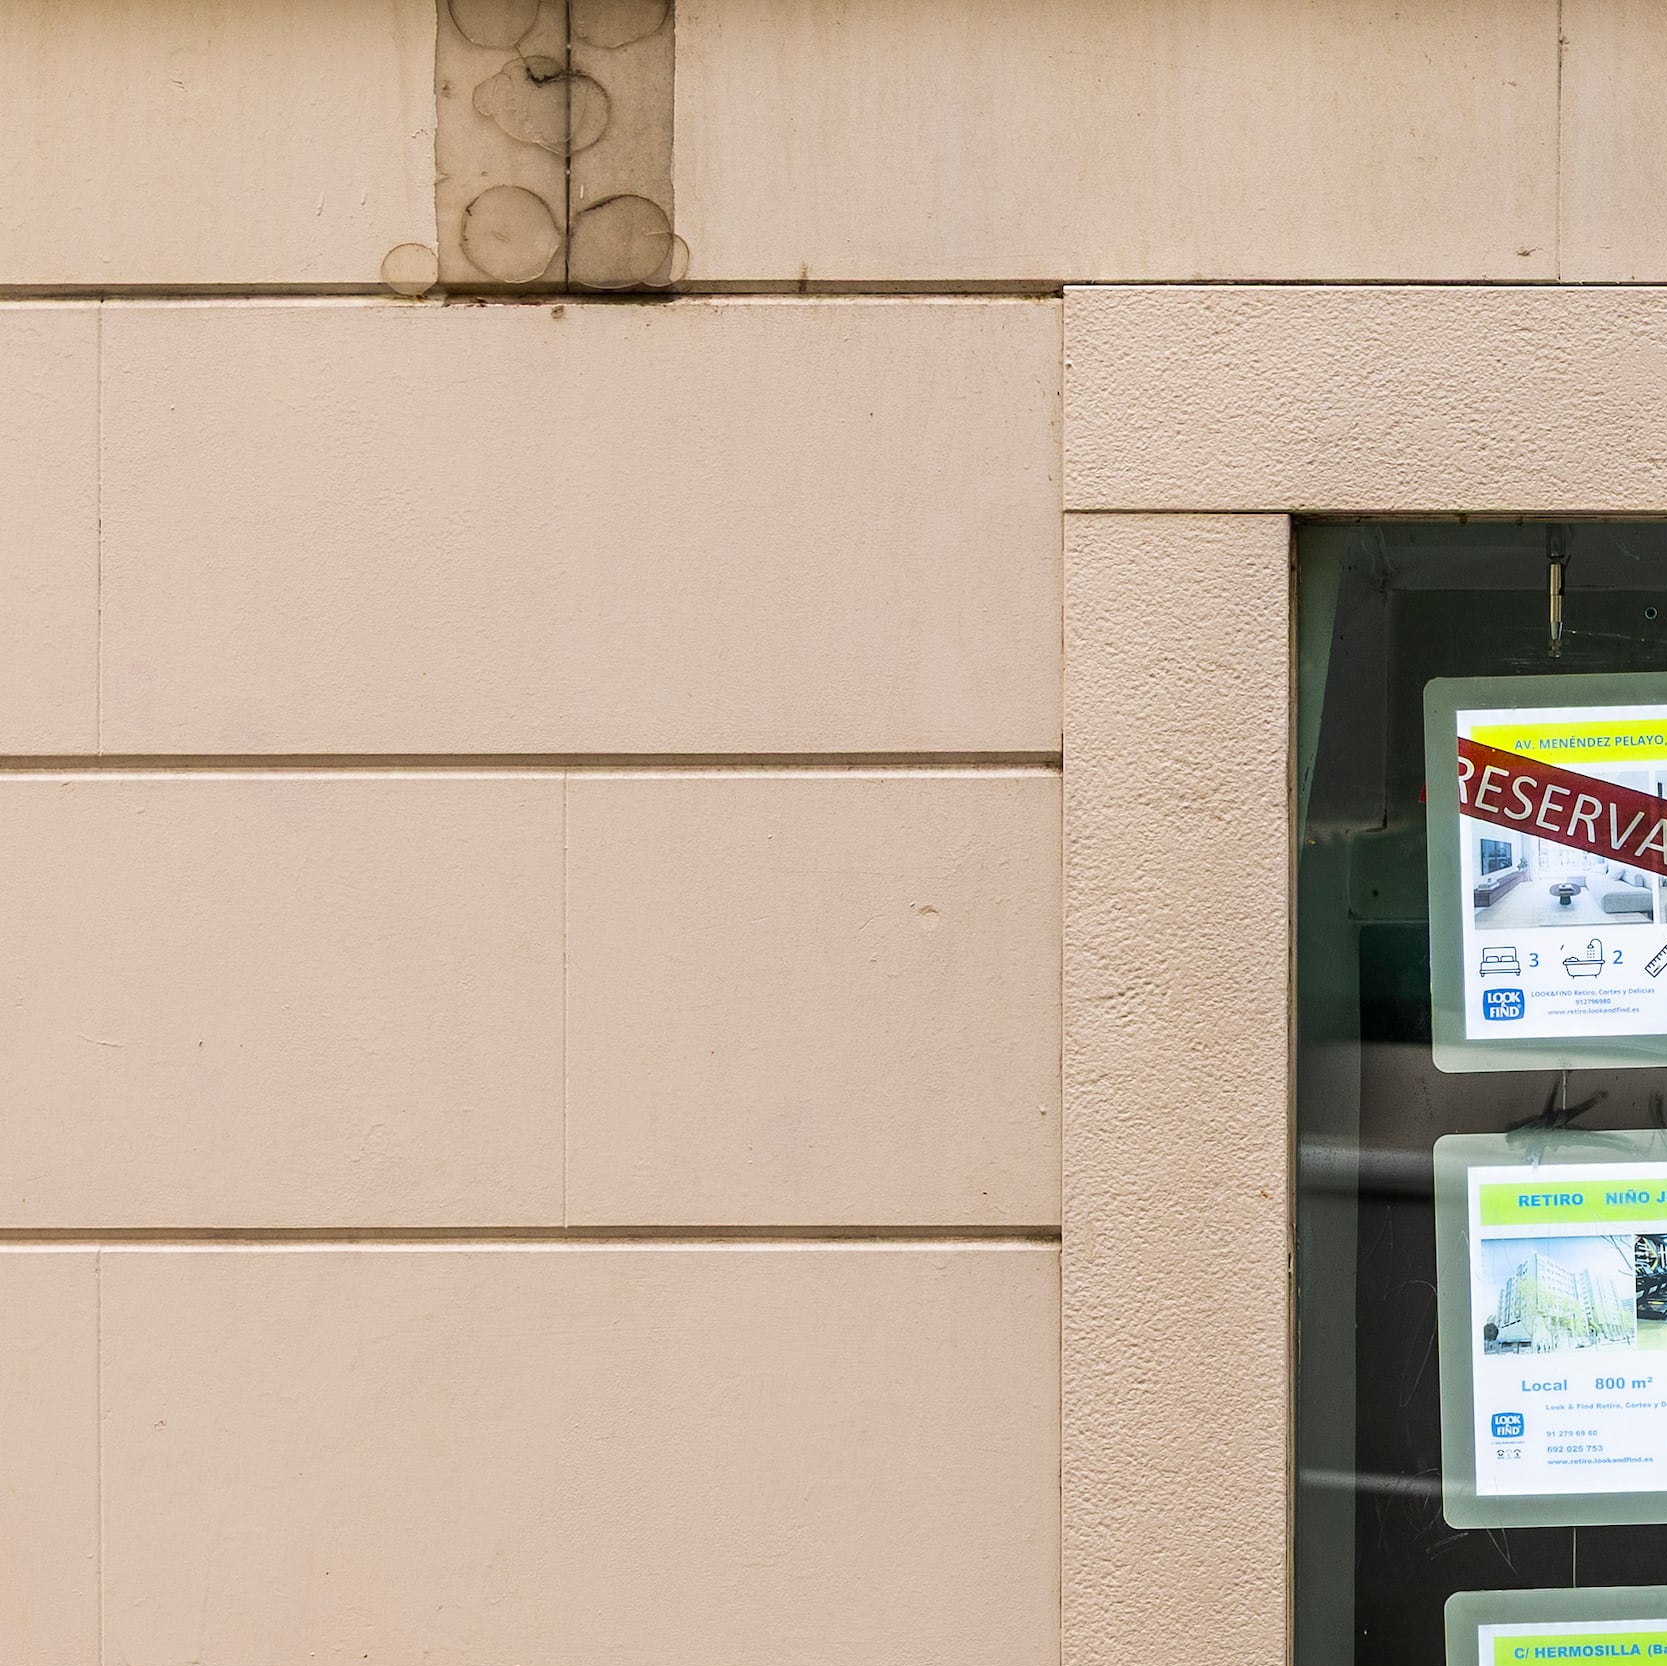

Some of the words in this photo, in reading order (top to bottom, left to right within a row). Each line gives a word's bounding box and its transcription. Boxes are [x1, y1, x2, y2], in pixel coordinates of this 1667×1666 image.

[1514, 738, 1535, 752] AV.
[1538, 735, 1611, 750] MENÉNDEZ
[1614, 734, 1667, 747] PELAYO,
[1518, 1192, 1584, 1208] RETIRO
[1605, 1188, 1651, 1205] NIÑO
[1513, 1647, 1530, 1660] C/
[1533, 1643, 1641, 1659] HERMOSILLA
